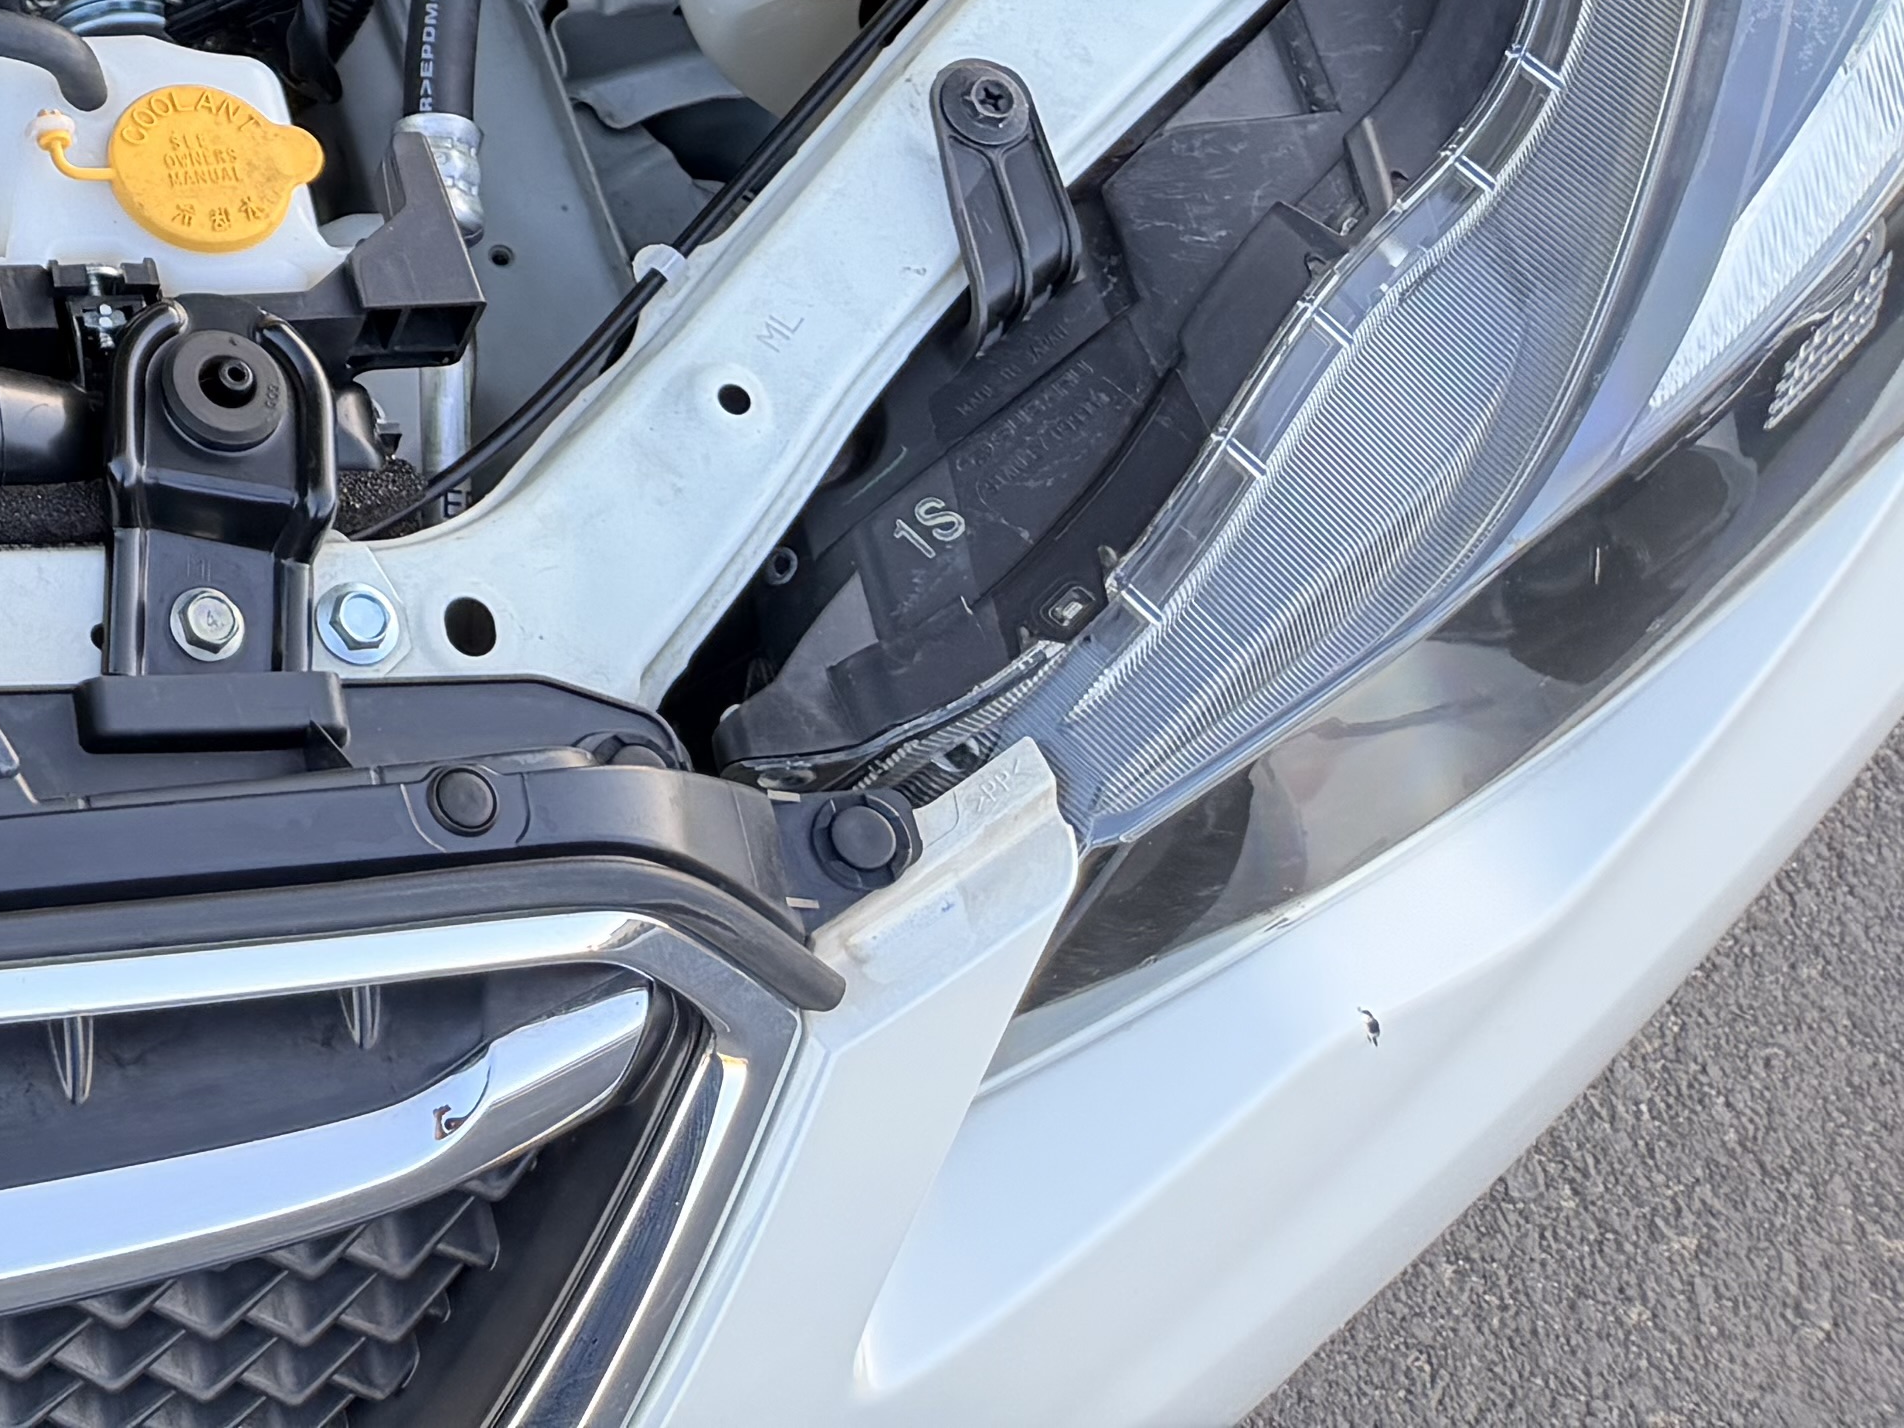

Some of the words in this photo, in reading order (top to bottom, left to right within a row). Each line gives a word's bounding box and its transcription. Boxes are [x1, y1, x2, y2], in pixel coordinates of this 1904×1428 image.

[120, 90, 264, 146] COOLANT
[168, 166, 241, 188] MANUAL
[756, 314, 805, 353] ML
[893, 496, 966, 560] 1S
